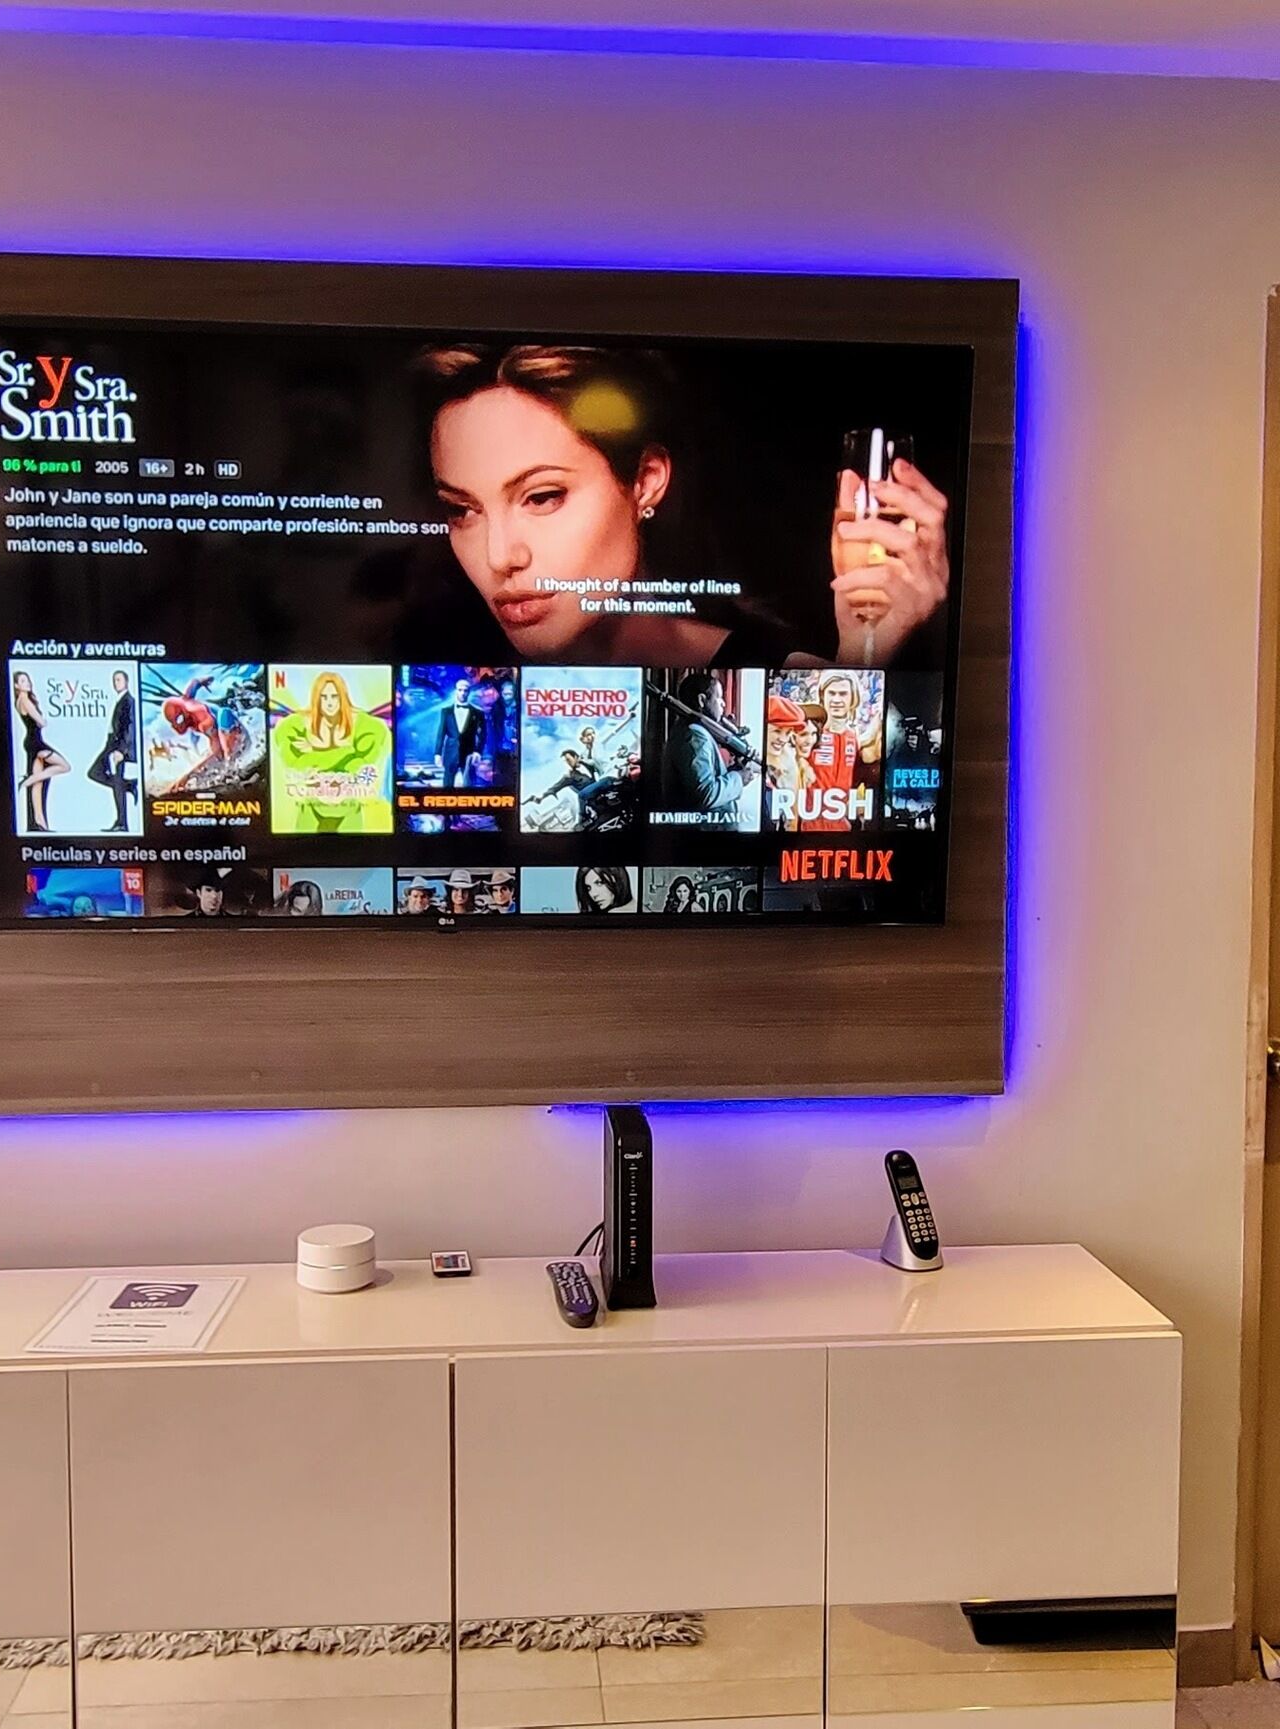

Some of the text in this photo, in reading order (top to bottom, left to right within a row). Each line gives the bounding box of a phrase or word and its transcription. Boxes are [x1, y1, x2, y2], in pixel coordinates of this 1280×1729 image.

[36, 356, 73, 409] y
[74, 365, 137, 402] Sra.
[0, 386, 137, 443] Smith
[39, 461, 69, 475] para
[71, 460, 82, 473] ti
[95, 461, 129, 474] 2005
[144, 461, 168, 475] 16+
[184, 463, 205, 475] 2 h
[218, 463, 238, 476] HD
[4, 487, 382, 511] John y Jane son una pareja común y corriente en
[5, 513, 449, 535] apariencia que ignora que comparte profesión: ambos son
[7, 538, 148, 554] matones a sueldo.
[544, 578, 601, 594] thought
[603, 579, 619, 592] of
[621, 582, 630, 592] a
[632, 579, 687, 593] number
[689, 580, 705, 594] of
[707, 580, 740, 594] lines
[580, 598, 696, 613] for this moment.
[12, 639, 166, 658] Acción y aventuras
[65, 680, 79, 703] y
[525, 689, 628, 703] ENCUENTRO
[48, 694, 107, 718] Smith
[527, 704, 626, 718] EXPLOSIVO
[893, 769, 929, 779] REYES
[893, 778, 907, 788] LA
[152, 801, 261, 816] SPIDER-MAN
[398, 795, 514, 808] EL REDENTOR
[771, 787, 874, 822] RUSH
[22, 846, 246, 864] Películas y series en español
[780, 850, 894, 883] NETFLIX
[127, 879, 140, 889] 10
